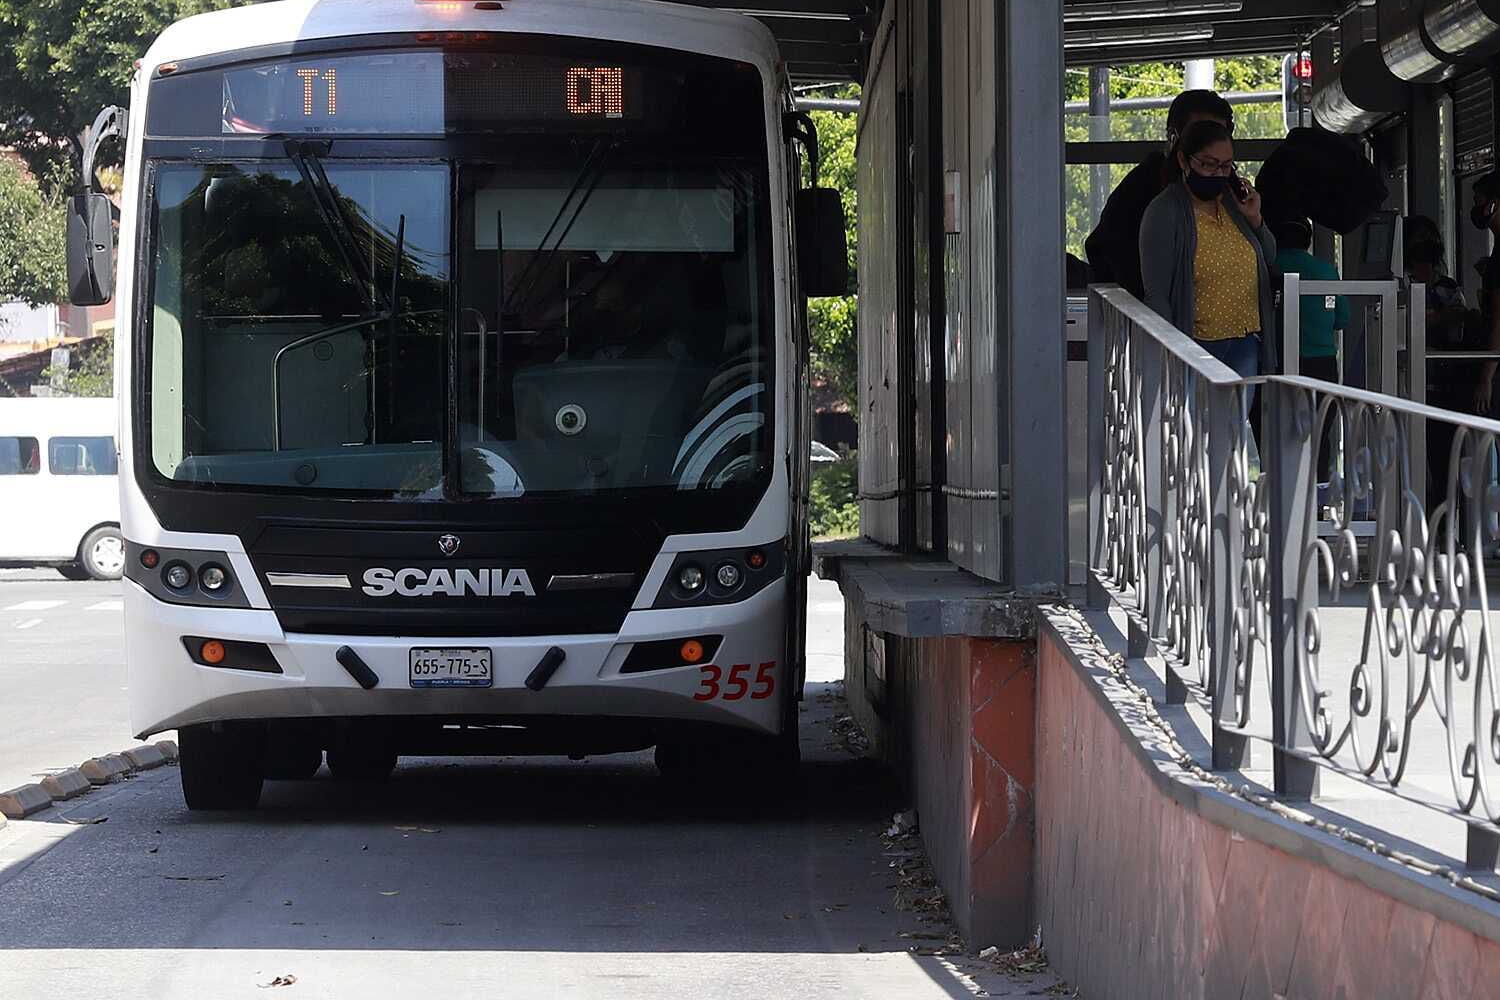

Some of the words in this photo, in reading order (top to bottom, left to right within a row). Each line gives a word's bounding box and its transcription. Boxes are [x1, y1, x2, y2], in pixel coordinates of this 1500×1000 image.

[297, 69, 336, 115] T1
[361, 567, 537, 598] SCANIA
[414, 658, 488, 676] 655-775-S
[693, 660, 777, 701] 355
